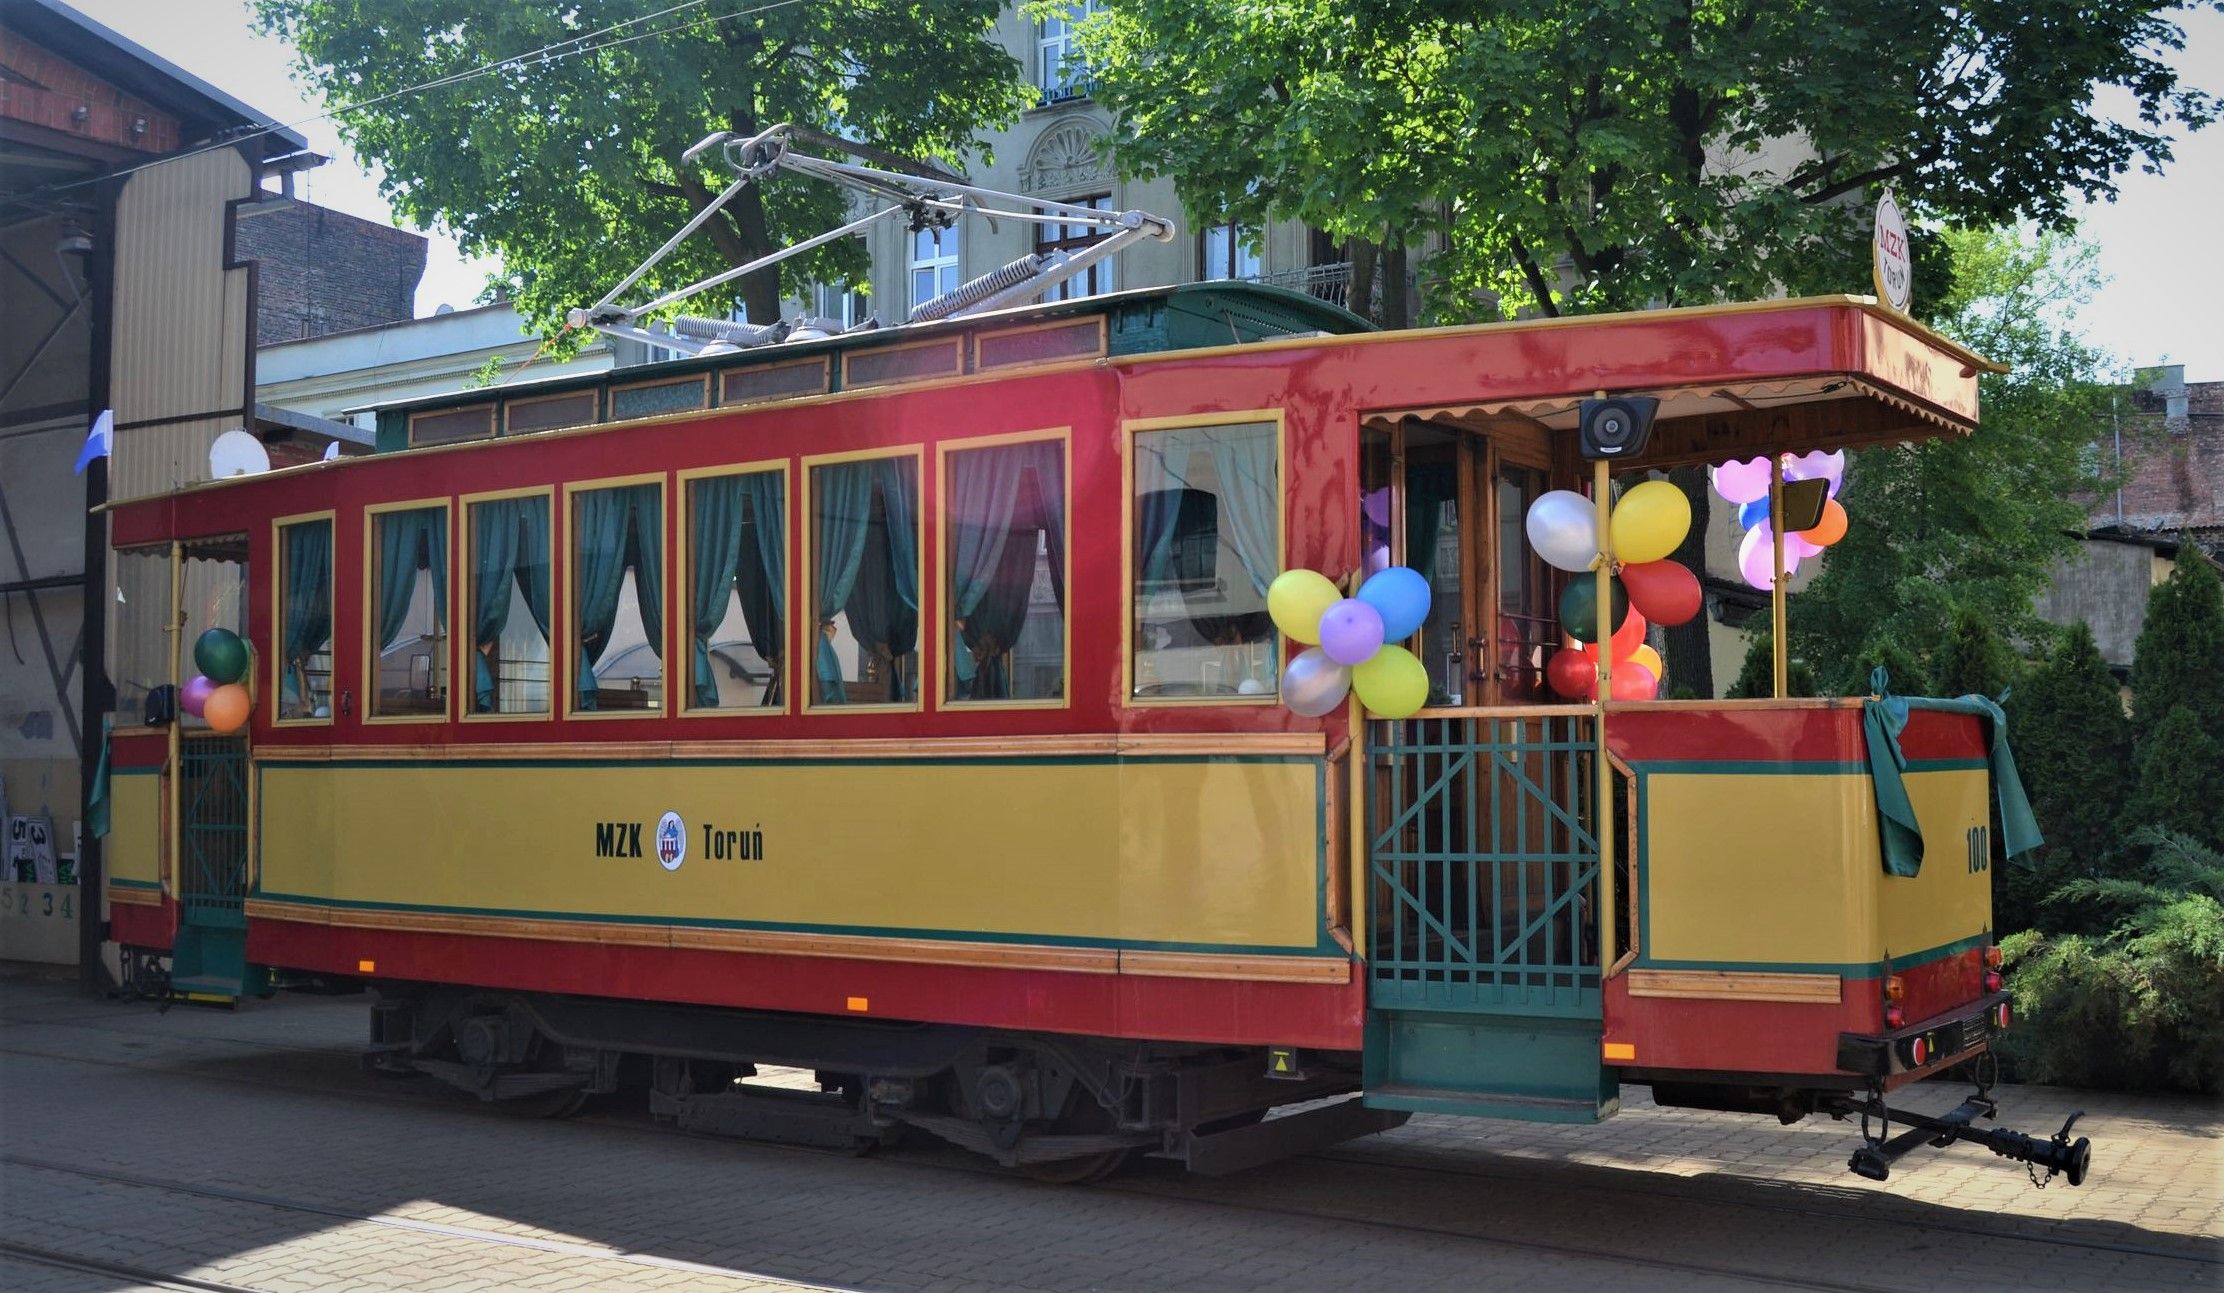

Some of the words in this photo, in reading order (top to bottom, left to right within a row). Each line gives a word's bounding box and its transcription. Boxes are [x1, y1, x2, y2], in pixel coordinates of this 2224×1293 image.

[1880, 224, 1905, 262] MZK
[596, 822, 643, 859] MZK
[703, 823, 763, 861] Toruń
[1967, 825, 1987, 874] 100
[43, 892, 53, 917] 3
